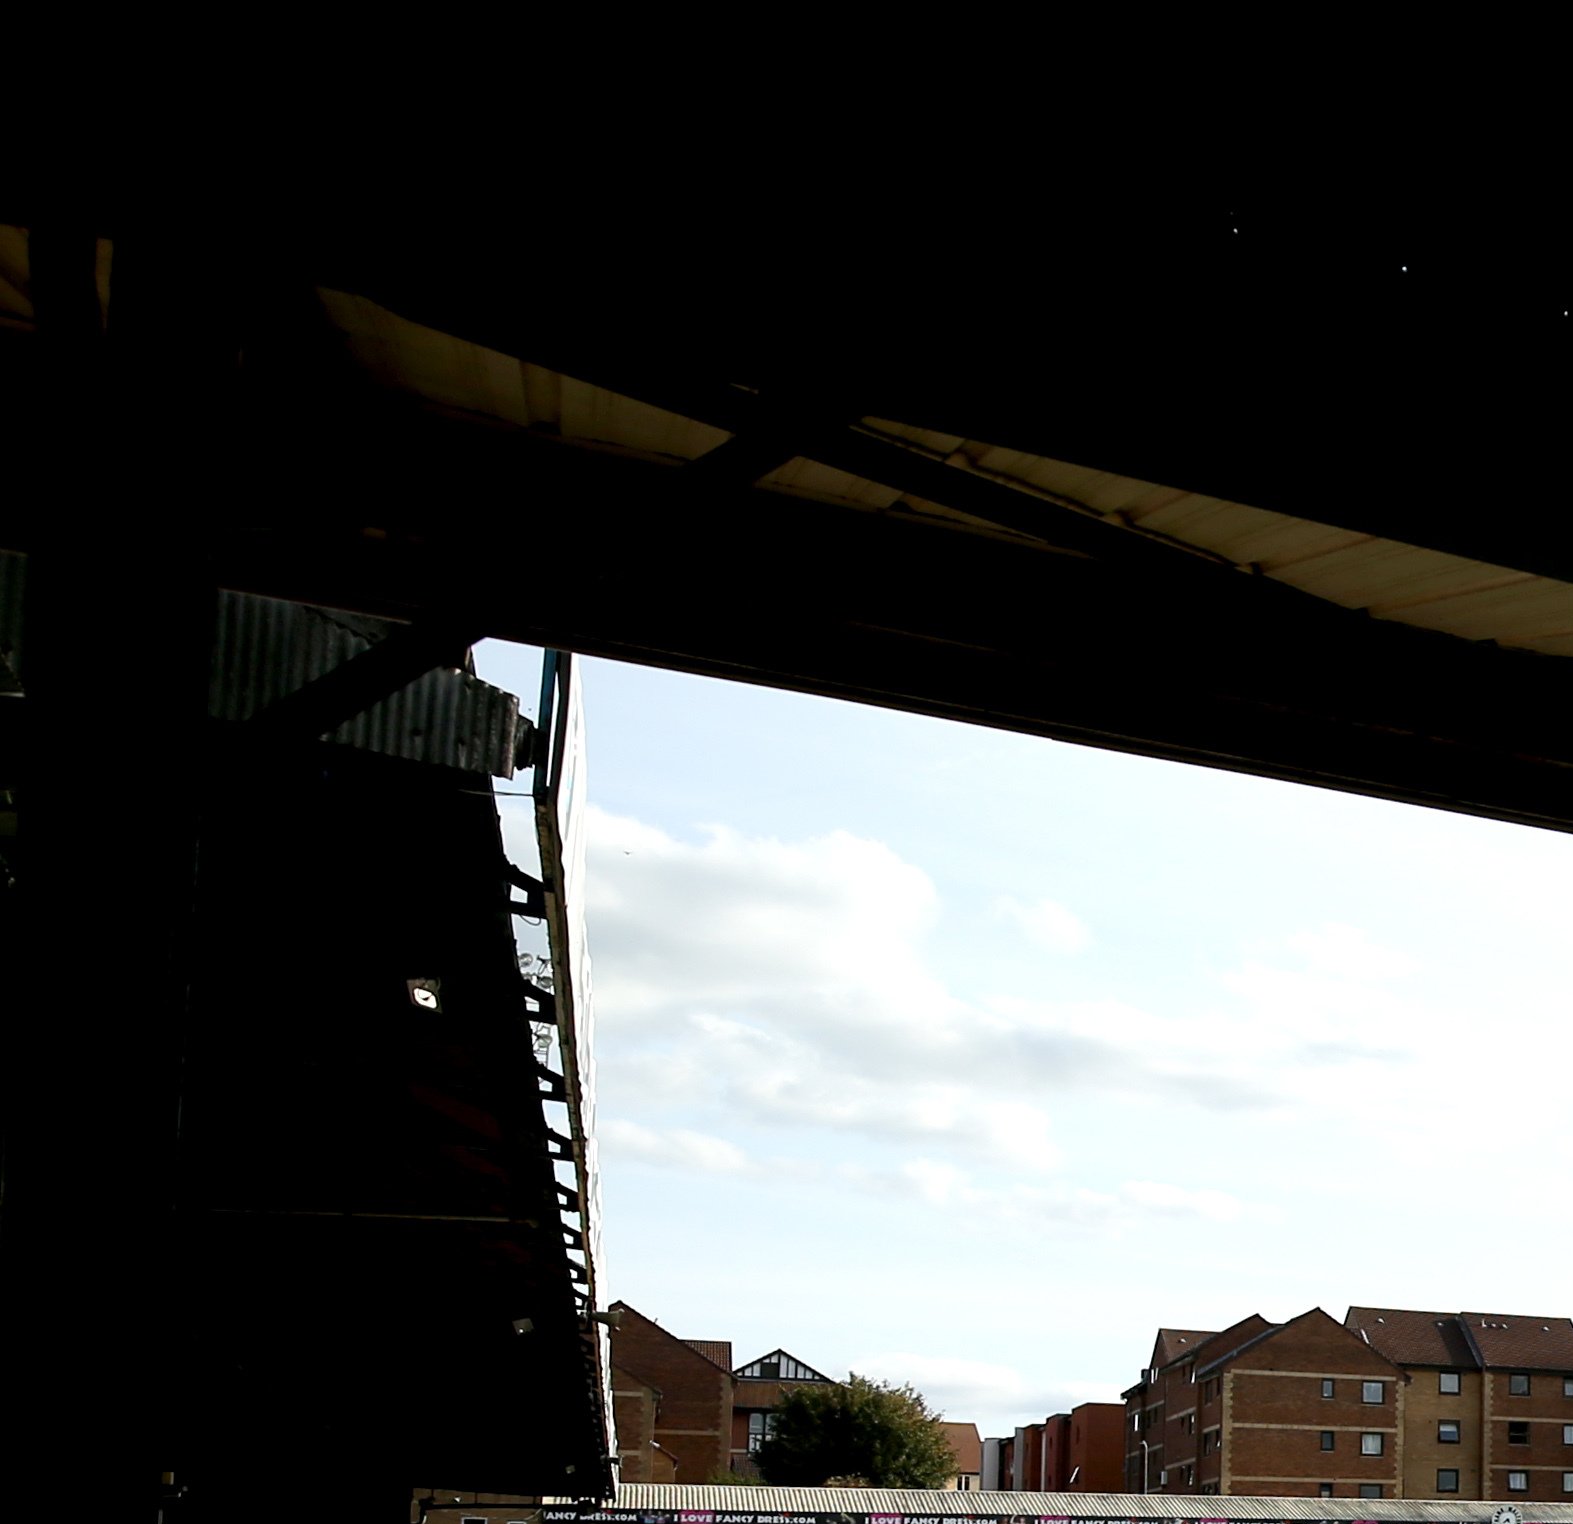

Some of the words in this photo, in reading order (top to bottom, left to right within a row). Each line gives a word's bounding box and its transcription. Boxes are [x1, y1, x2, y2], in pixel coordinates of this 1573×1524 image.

[680, 1514, 714, 1523] LOVE
[716, 1515, 755, 1524] FANCY
[871, 1517, 901, 1524] LOVE
